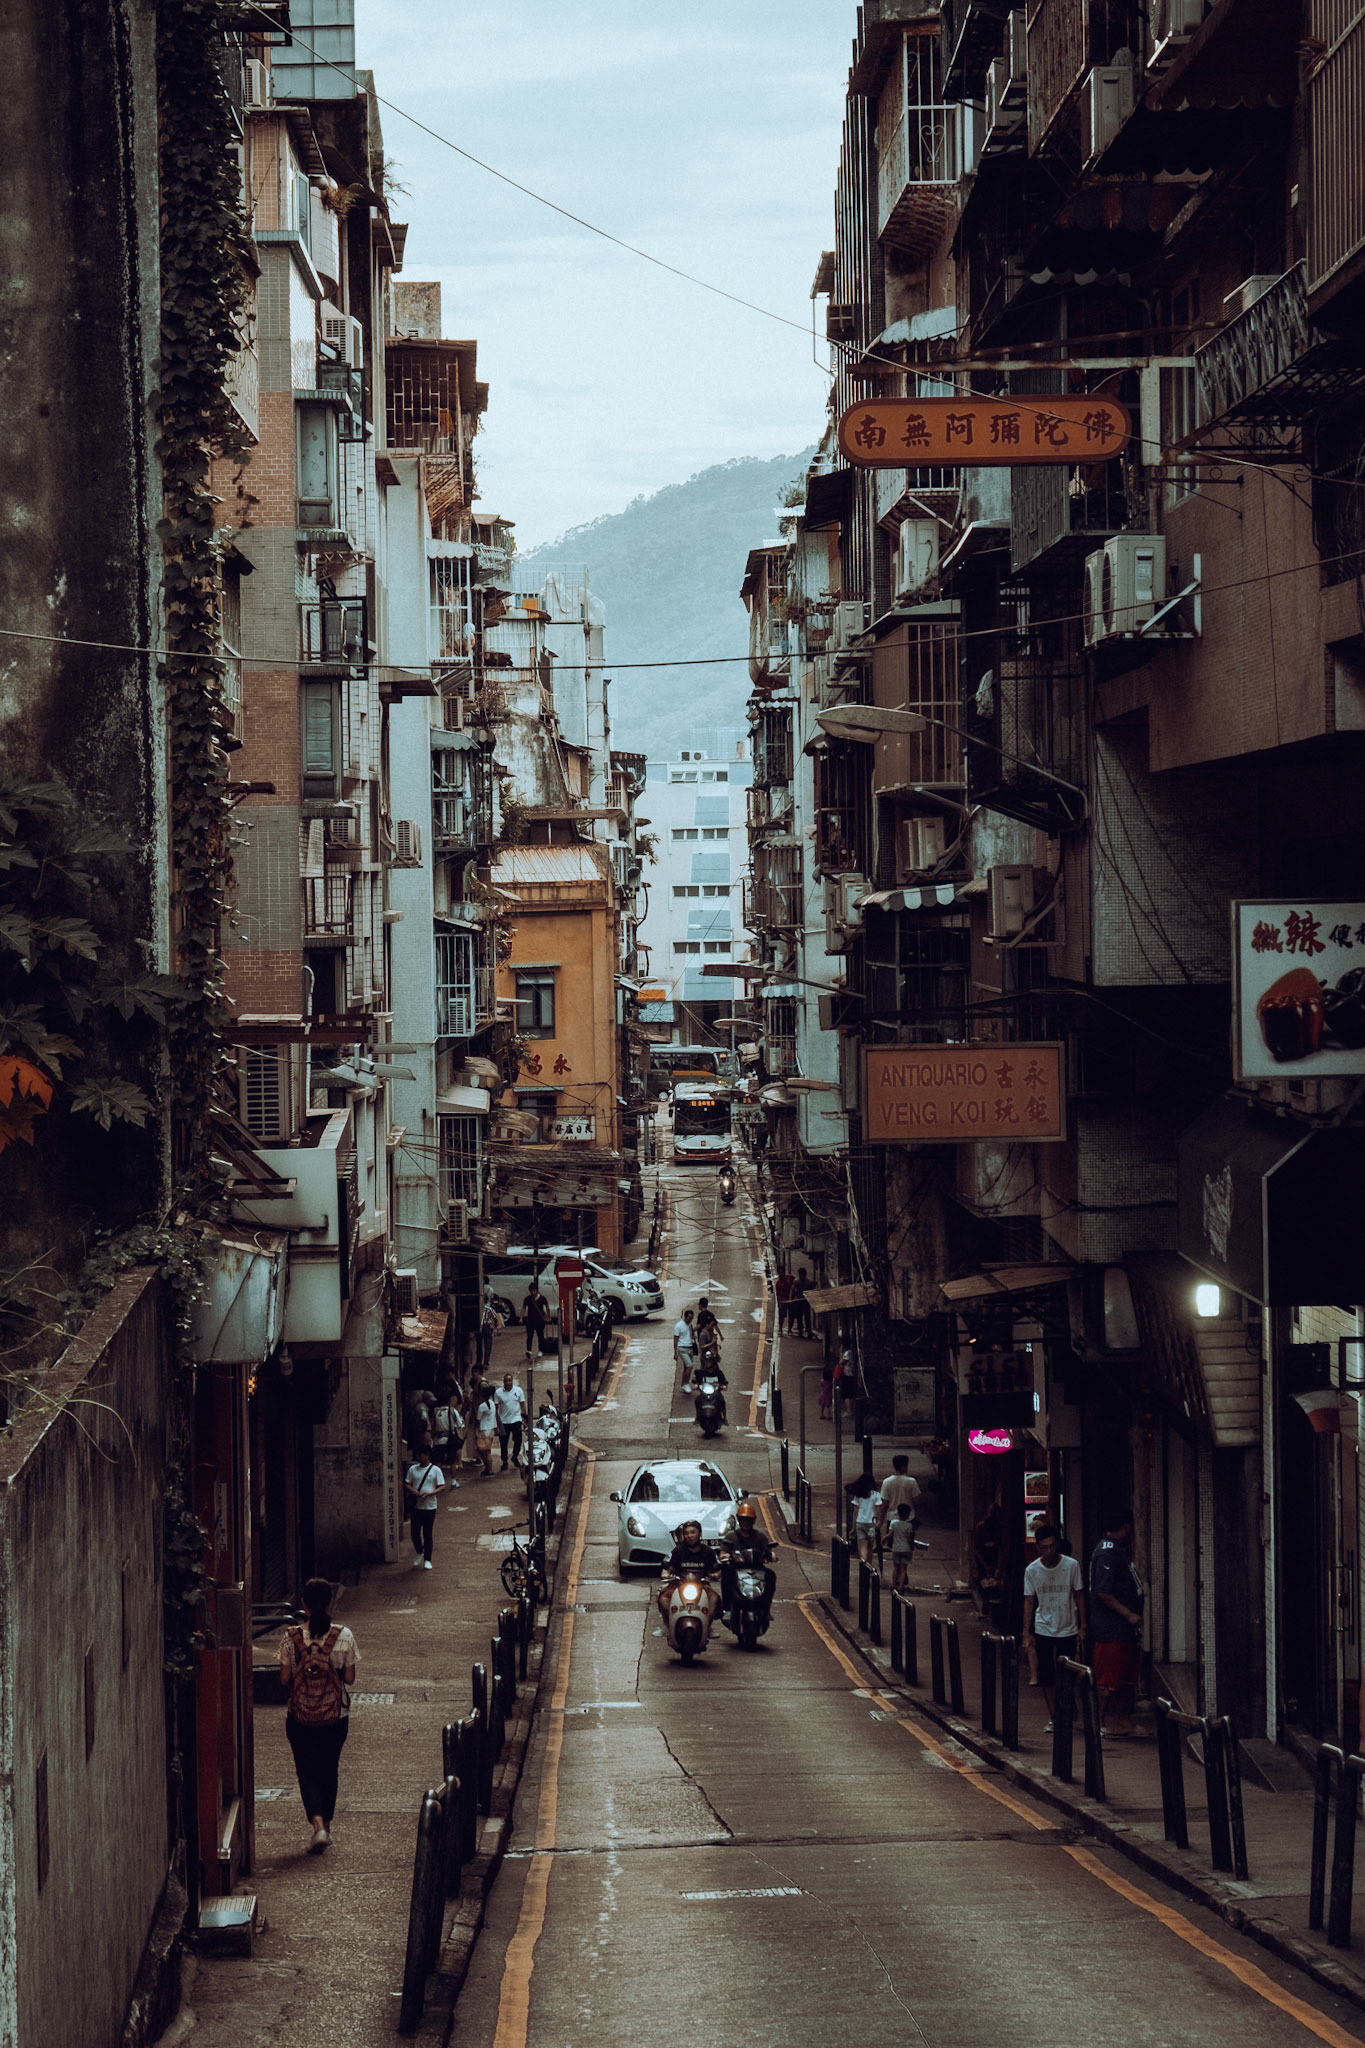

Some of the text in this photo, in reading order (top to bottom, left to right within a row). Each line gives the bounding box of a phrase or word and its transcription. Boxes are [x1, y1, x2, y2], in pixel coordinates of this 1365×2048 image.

[854, 409, 1116, 449] 南無阿彌陀佛
[880, 1063, 988, 1087] ANTIQUARIO
[880, 1101, 986, 1127] VENG KOI
